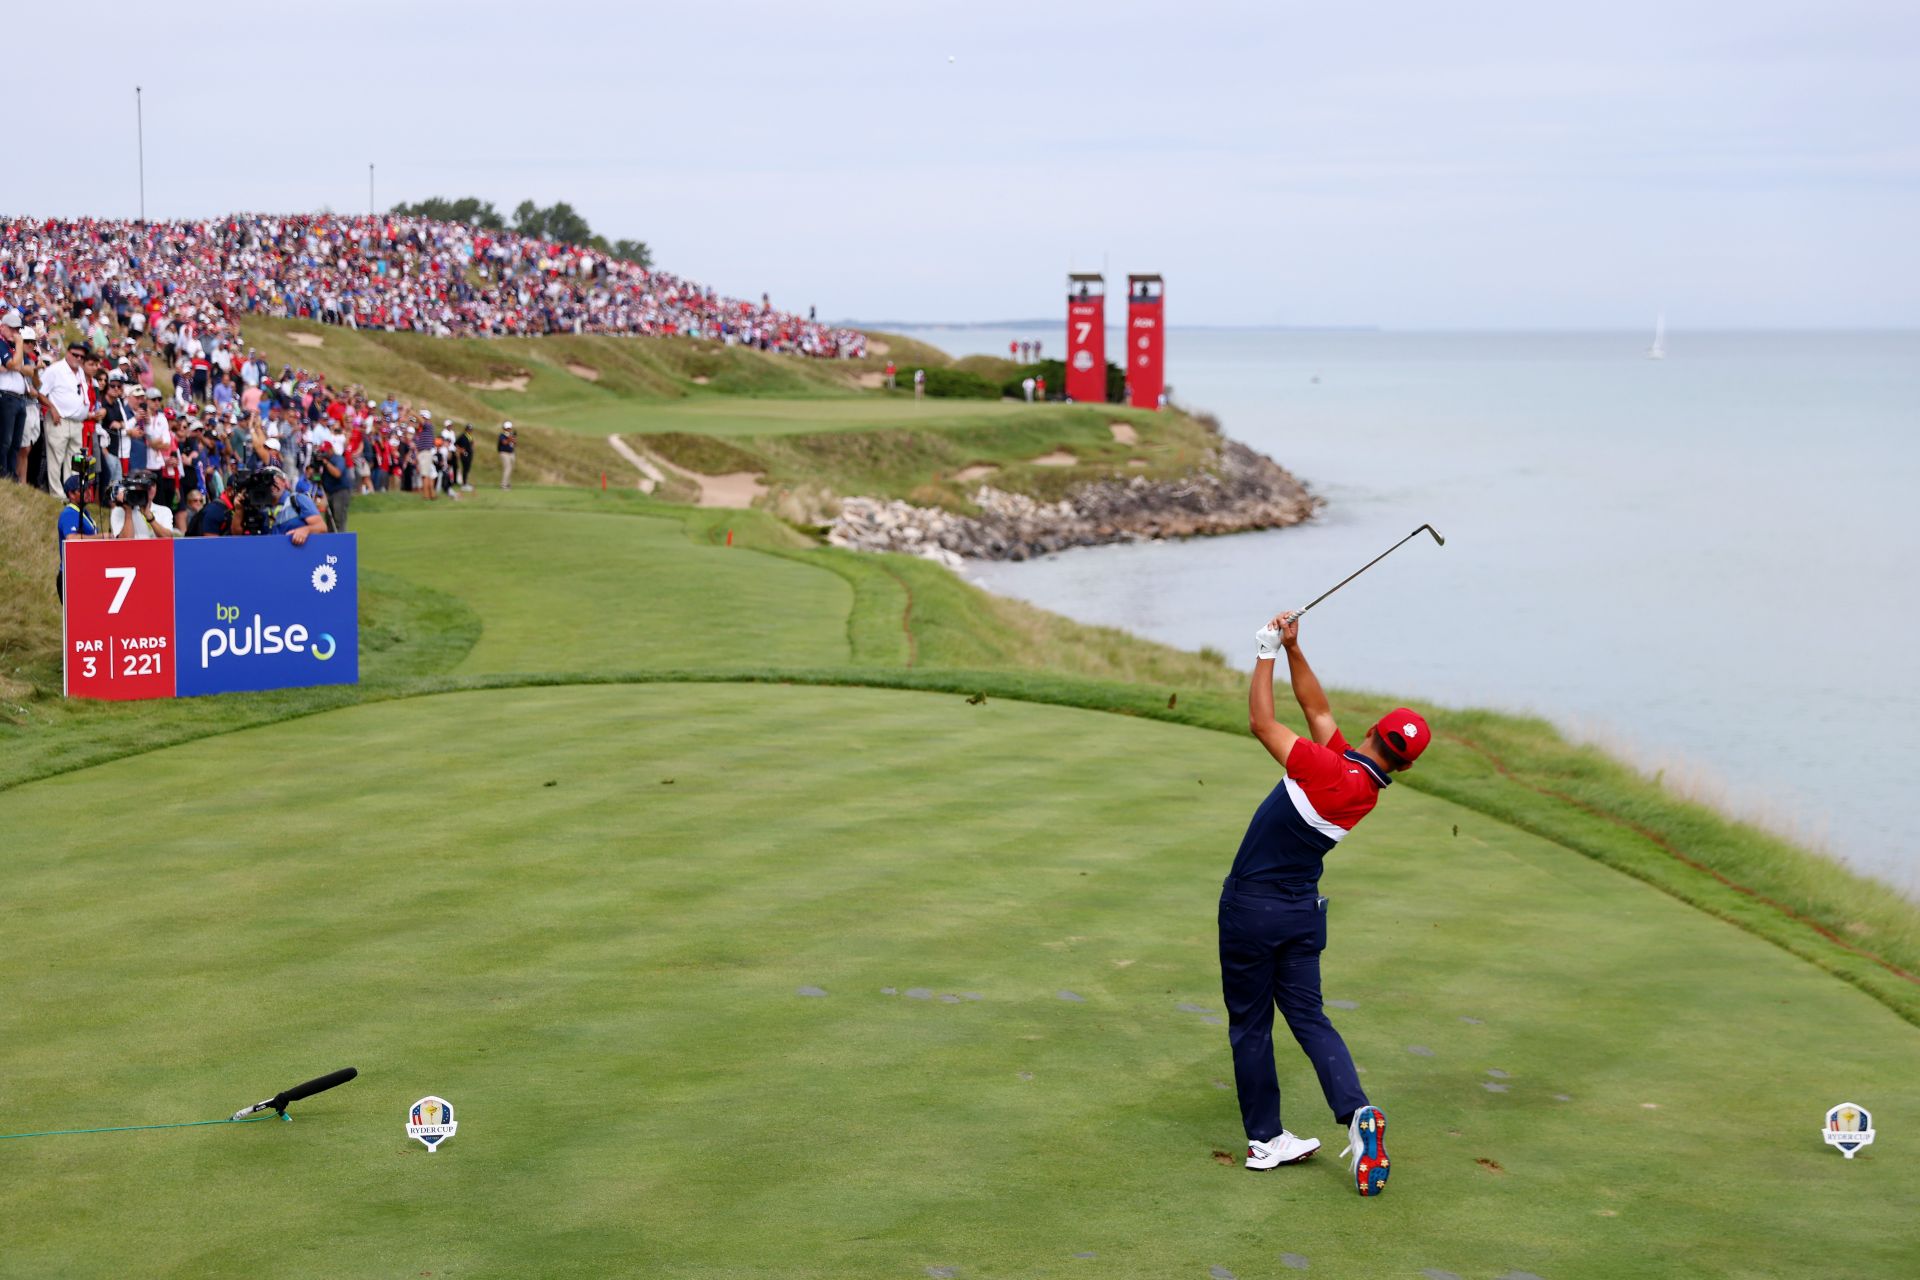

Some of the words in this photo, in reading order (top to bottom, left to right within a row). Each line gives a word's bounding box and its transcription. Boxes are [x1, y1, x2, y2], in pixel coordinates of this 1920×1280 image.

[1075, 322, 1092, 344] 7
[326, 554, 338, 565] bp
[105, 567, 137, 614] 7
[216, 602, 240, 624] bp
[75, 639, 104, 653] PAR
[120, 636, 167, 650] YARDS
[201, 613, 309, 669] pulse
[82, 656, 97, 678] 3
[123, 652, 161, 677] 221
[410, 1126, 436, 1134] RYDER
